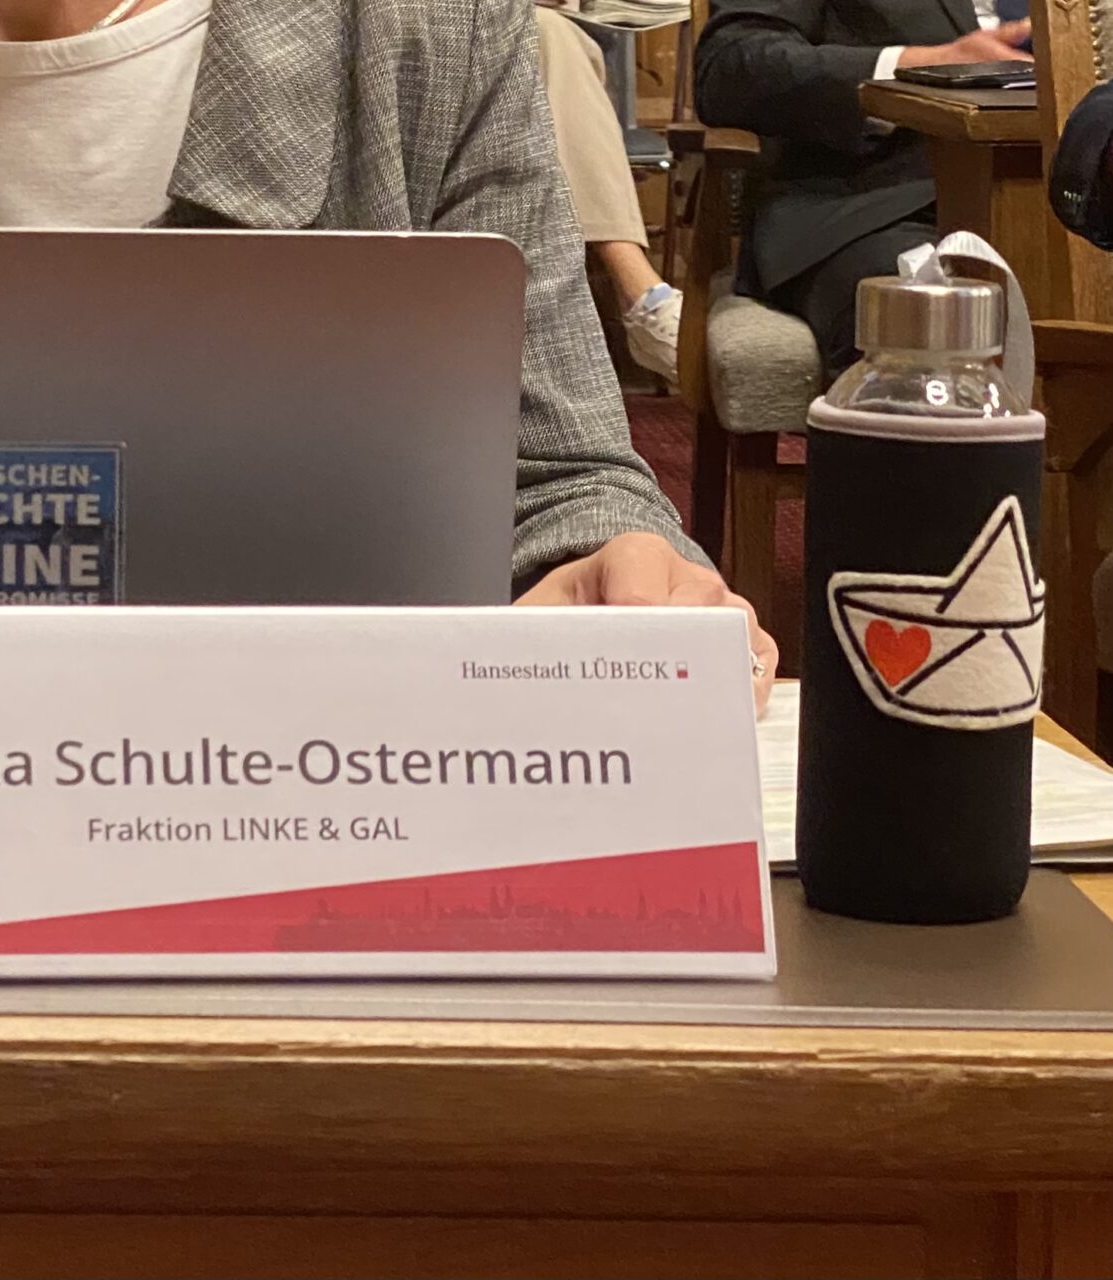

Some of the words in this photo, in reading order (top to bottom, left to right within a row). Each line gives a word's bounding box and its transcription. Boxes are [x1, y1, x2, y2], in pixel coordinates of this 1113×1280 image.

[461, 661, 571, 680] Hansestadt
[580, 656, 670, 680] LÜBECK
[55, 737, 632, 787] Schulte-Ostermann
[88, 817, 212, 842] Fraktion
[222, 817, 309, 841] LINKE
[318, 816, 341, 841] &
[349, 816, 409, 841] GAL
